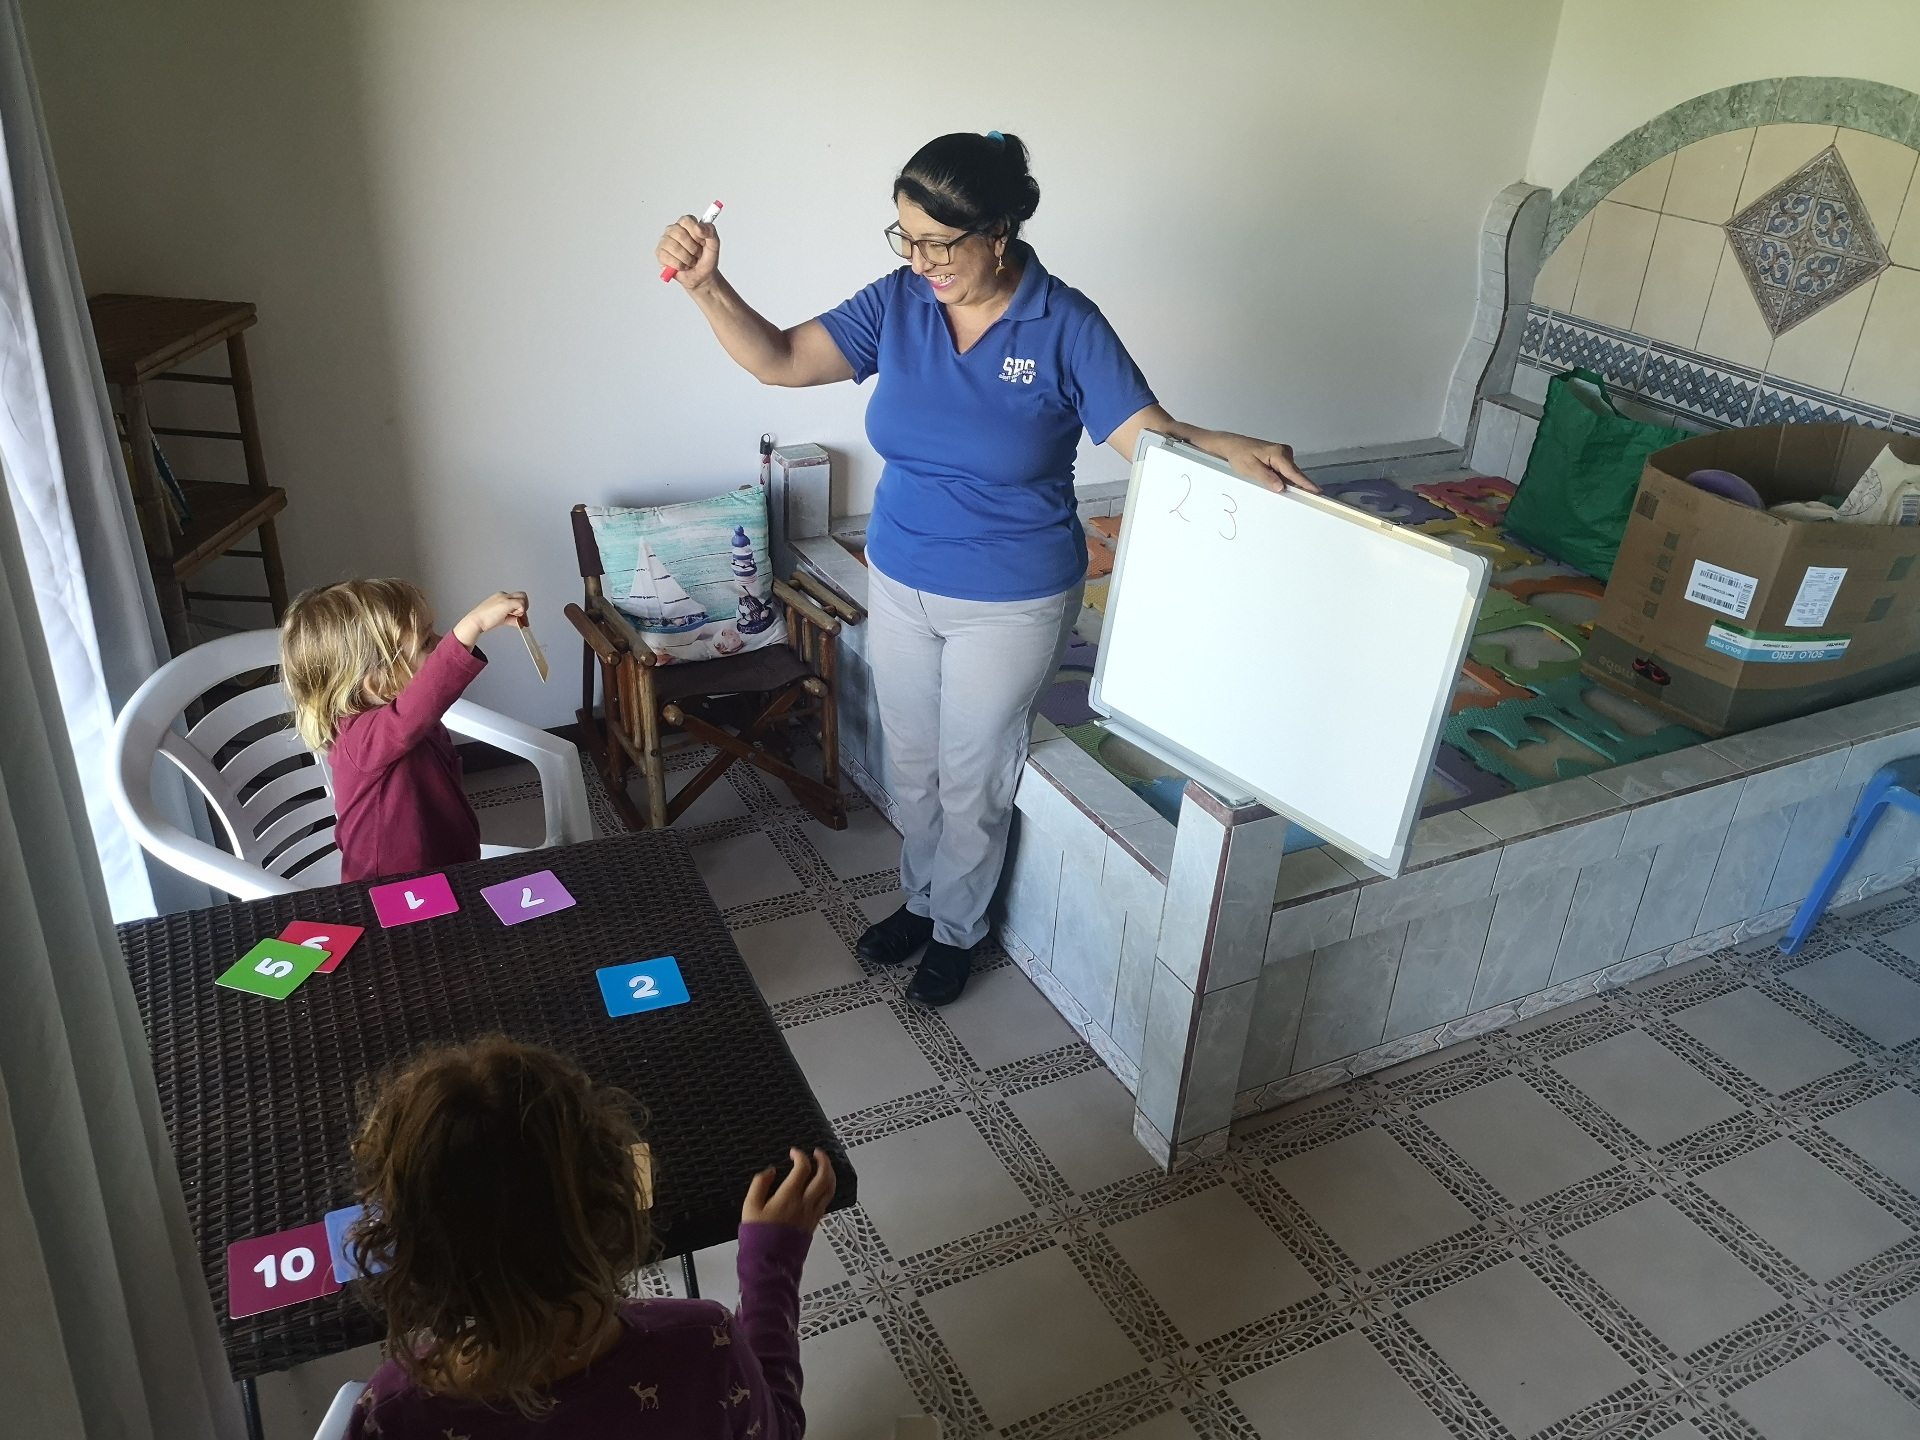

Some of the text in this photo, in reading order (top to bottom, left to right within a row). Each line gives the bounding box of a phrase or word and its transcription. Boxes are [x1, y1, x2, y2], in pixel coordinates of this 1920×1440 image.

[1169, 474, 1238, 541] 2 3
[1726, 645, 1742, 655] SOLO
[1800, 650, 1825, 659] SOLO
[404, 890, 425, 910] 1
[520, 887, 545, 909] 7
[254, 957, 294, 979] 5
[628, 975, 660, 999] 2
[253, 1247, 315, 1288] 10
